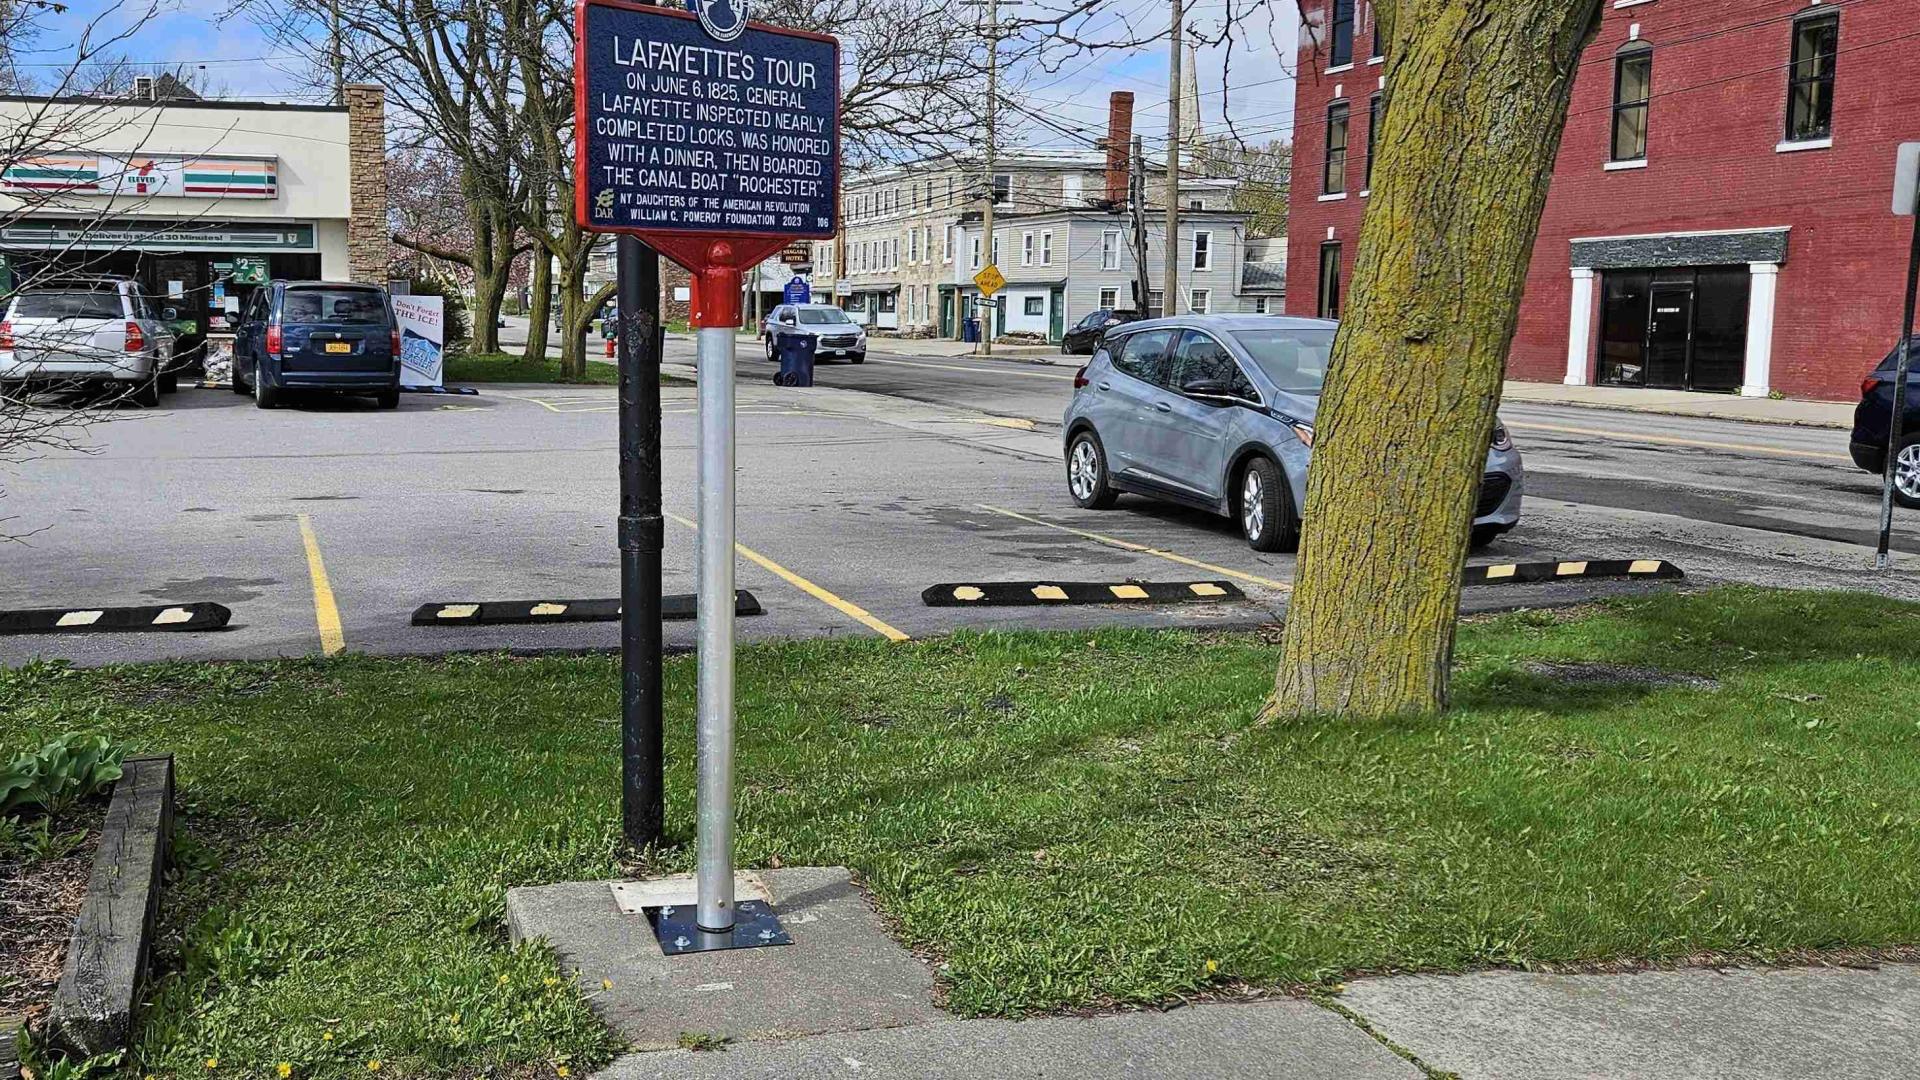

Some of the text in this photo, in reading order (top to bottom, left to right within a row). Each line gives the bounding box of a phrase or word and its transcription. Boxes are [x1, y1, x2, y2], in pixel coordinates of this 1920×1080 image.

[614, 35, 816, 90] LAFAYETTE'S TOUR
[626, 72, 646, 92] ON
[651, 75, 688, 97] JUNE
[746, 87, 806, 110] GENERAL
[602, 92, 825, 134] LAFAYETTE INSPECTED NEARLY
[596, 117, 830, 156] COMPLETED LOCKS, WAS HONORED
[607, 143, 822, 177] WITH A DINNER, THEN BOARDED
[603, 166, 634, 186] THE
[638, 169, 687, 189] CANAL
[691, 172, 728, 191] BOAT
[594, 207, 614, 219] DAR
[620, 193, 810, 214] NY DAUGHTERS OF THE AMERICAN REVOLUTION
[630, 208, 668, 221] WILLIAM
[683, 210, 722, 224] POMEROY
[725, 212, 776, 226] FOUNDATION
[782, 215, 802, 227] 2023
[817, 217, 830, 228] 106
[180, 234, 223, 242] Minutes!
[395, 308, 439, 327] THE ICE!
[396, 300, 439, 317] Don't Forget
